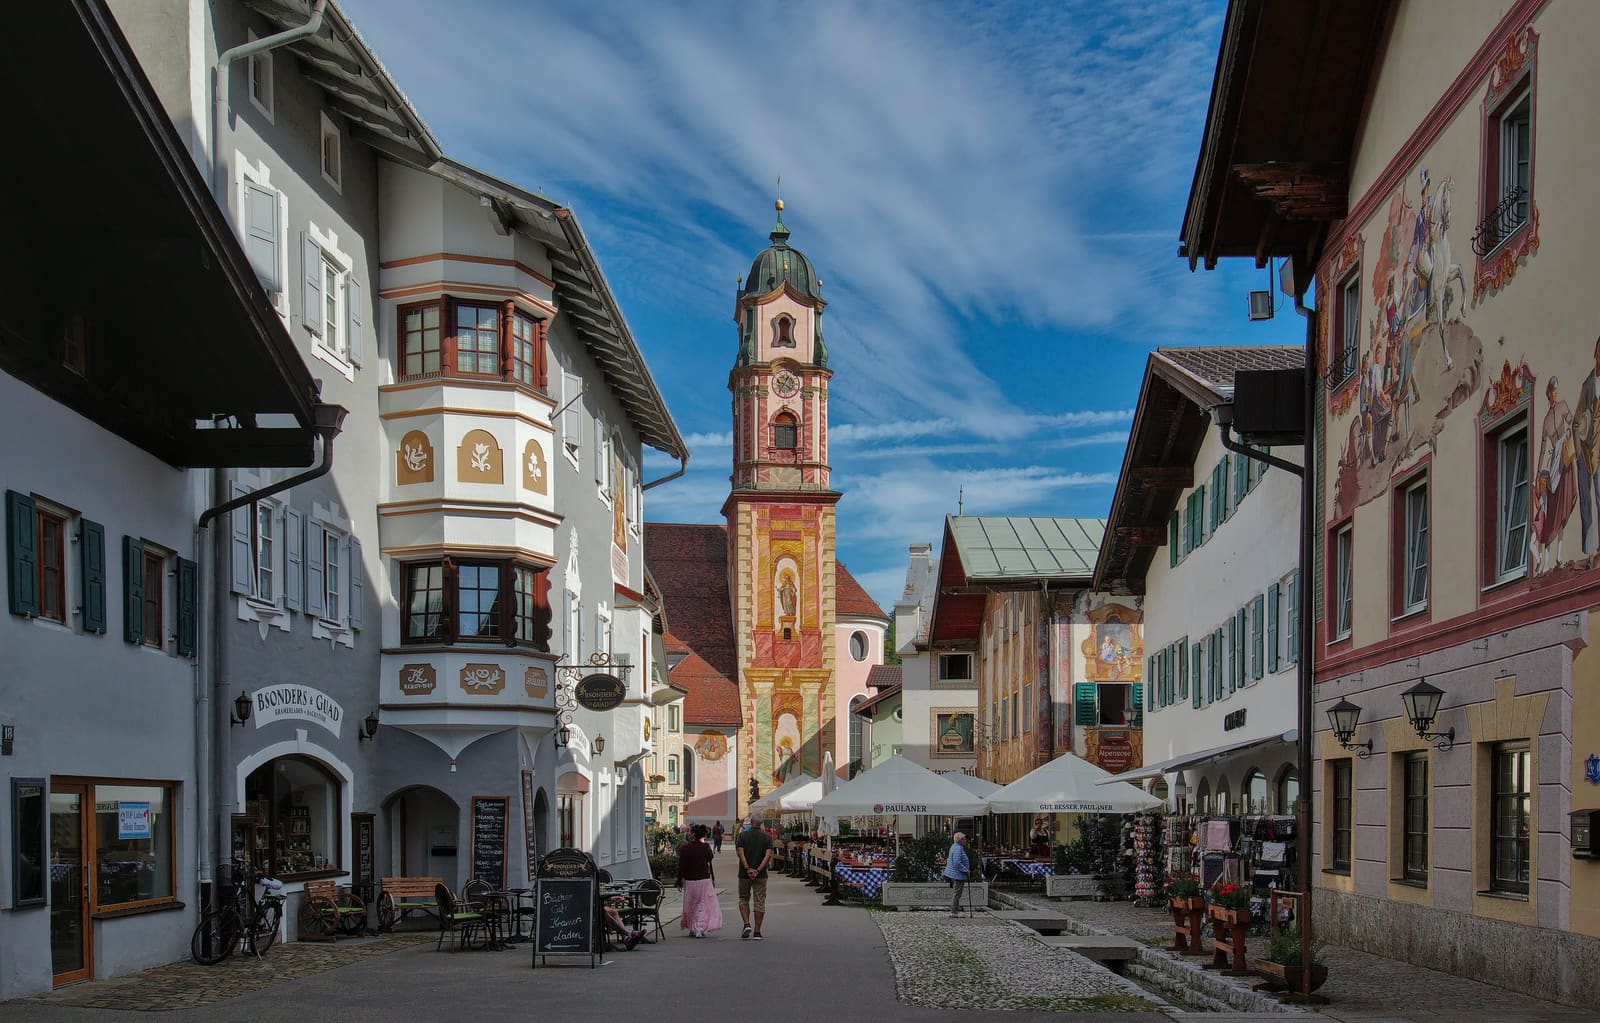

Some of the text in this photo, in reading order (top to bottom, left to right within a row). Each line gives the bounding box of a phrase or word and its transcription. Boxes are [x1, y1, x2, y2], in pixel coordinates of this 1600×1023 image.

[257, 688, 308, 711] BSONDERS
[316, 694, 339, 721] GUAD
[5, 726, 13, 740] 18
[885, 804, 927, 813] PAULANER
[553, 929, 584, 942] Laden
